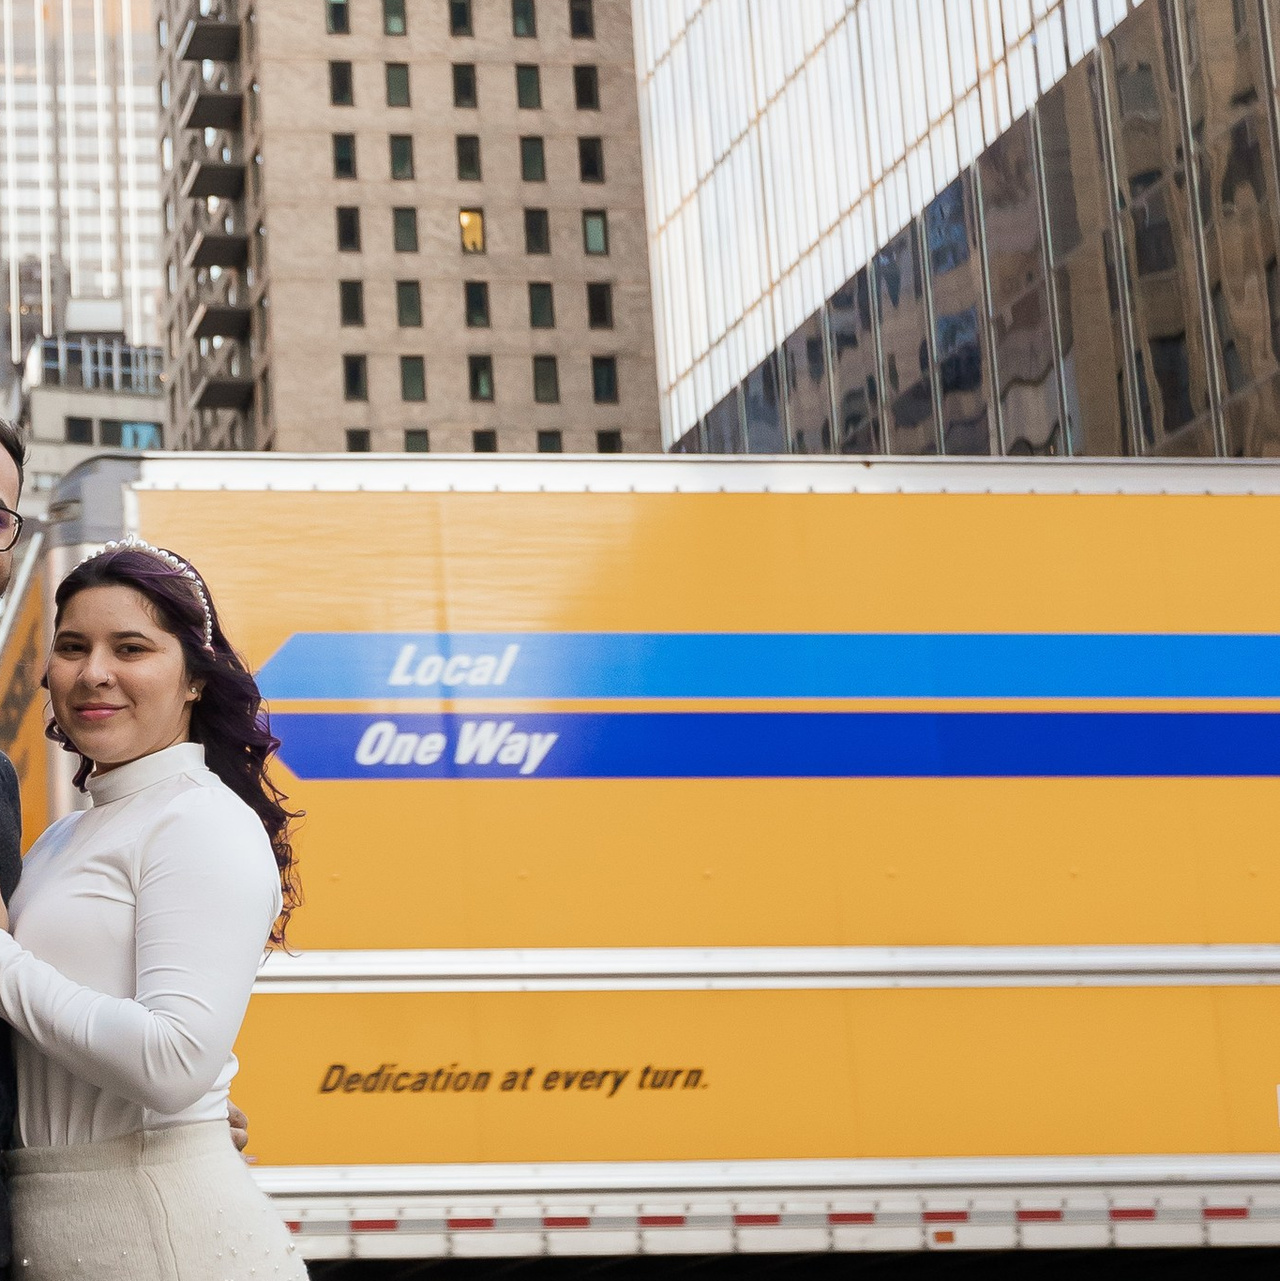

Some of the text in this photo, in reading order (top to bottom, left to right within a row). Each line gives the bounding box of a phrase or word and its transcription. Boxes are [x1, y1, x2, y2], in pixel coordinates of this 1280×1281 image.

[388, 643, 519, 686] Local
[355, 720, 559, 775] One Way
[319, 1063, 709, 1099] Dedication at every turn.
